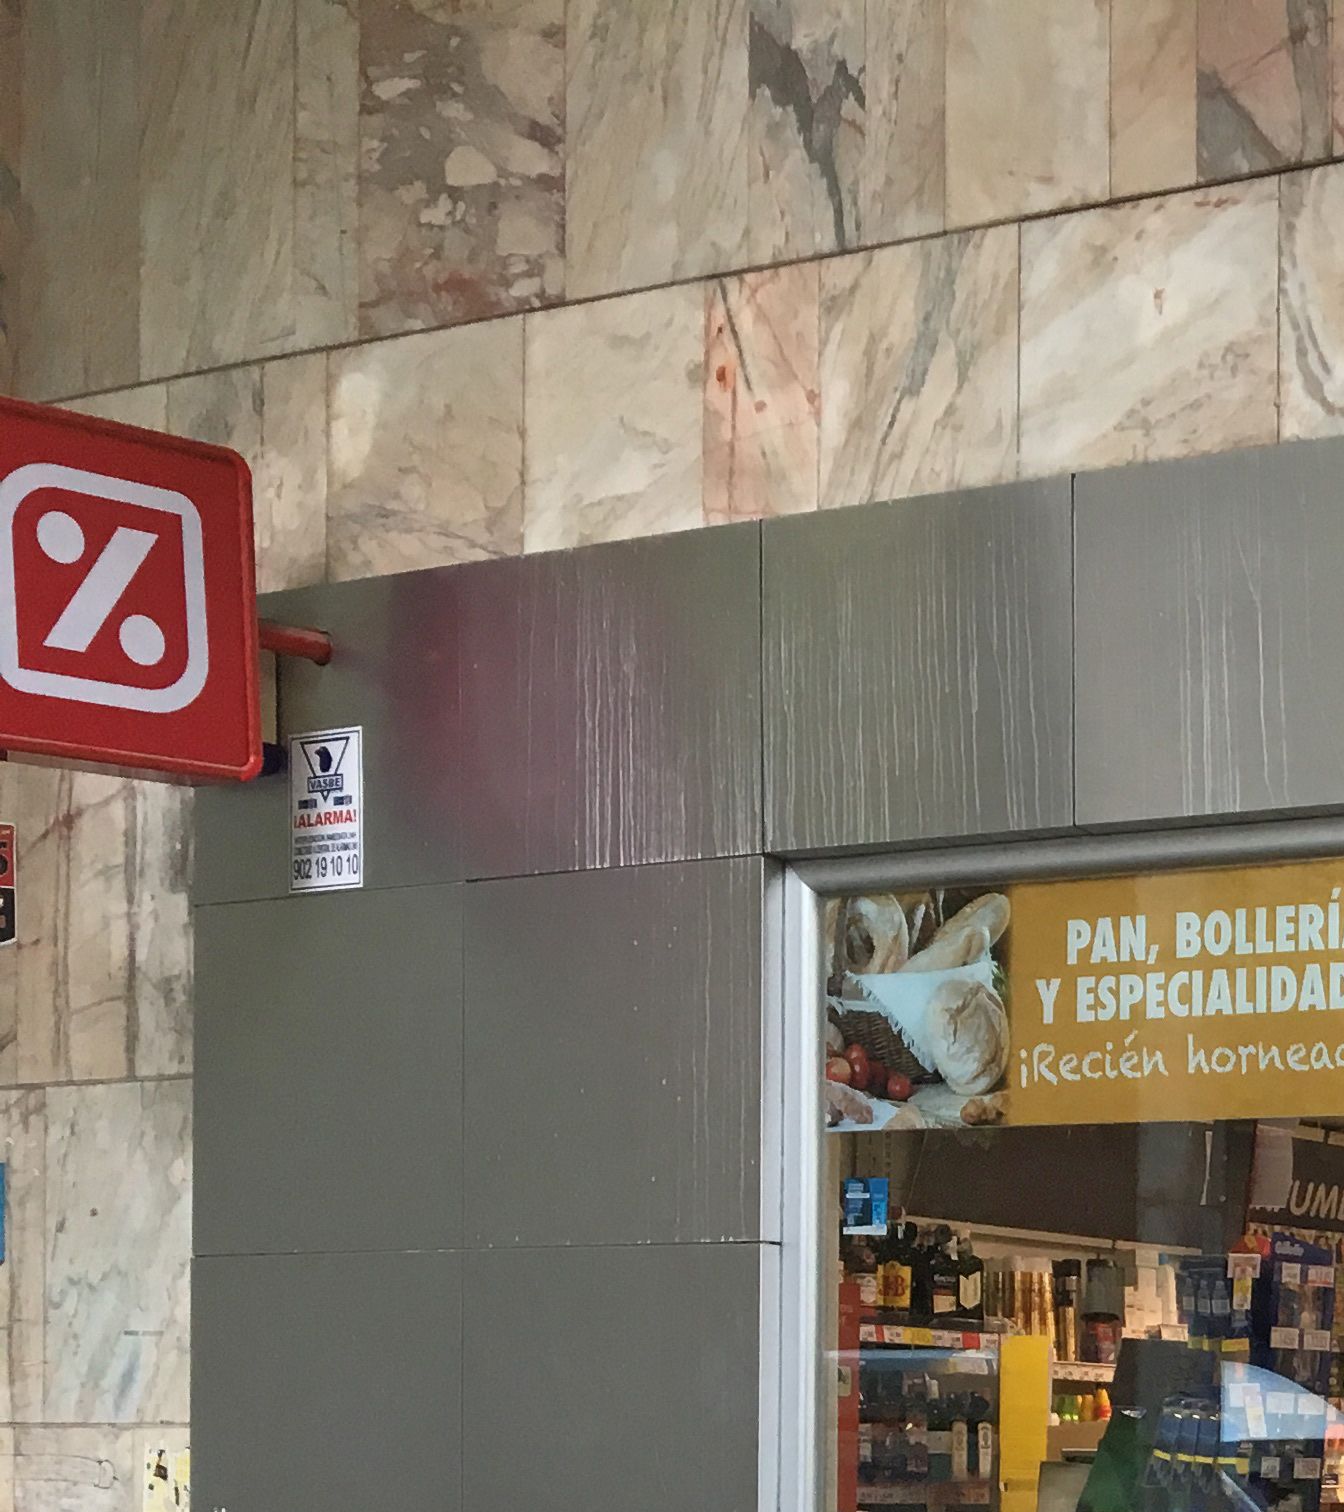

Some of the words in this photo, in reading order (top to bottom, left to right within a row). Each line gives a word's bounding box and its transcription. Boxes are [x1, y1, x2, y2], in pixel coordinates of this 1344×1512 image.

[294, 858, 312, 880] 902
[315, 857, 327, 878] 19
[330, 855, 342, 876] 10
[347, 853, 359, 875] 10
[1066, 914, 1159, 965] PAN,
[1036, 978, 1060, 1025] Y
[1020, 1030, 1167, 1089] ¡Recién
